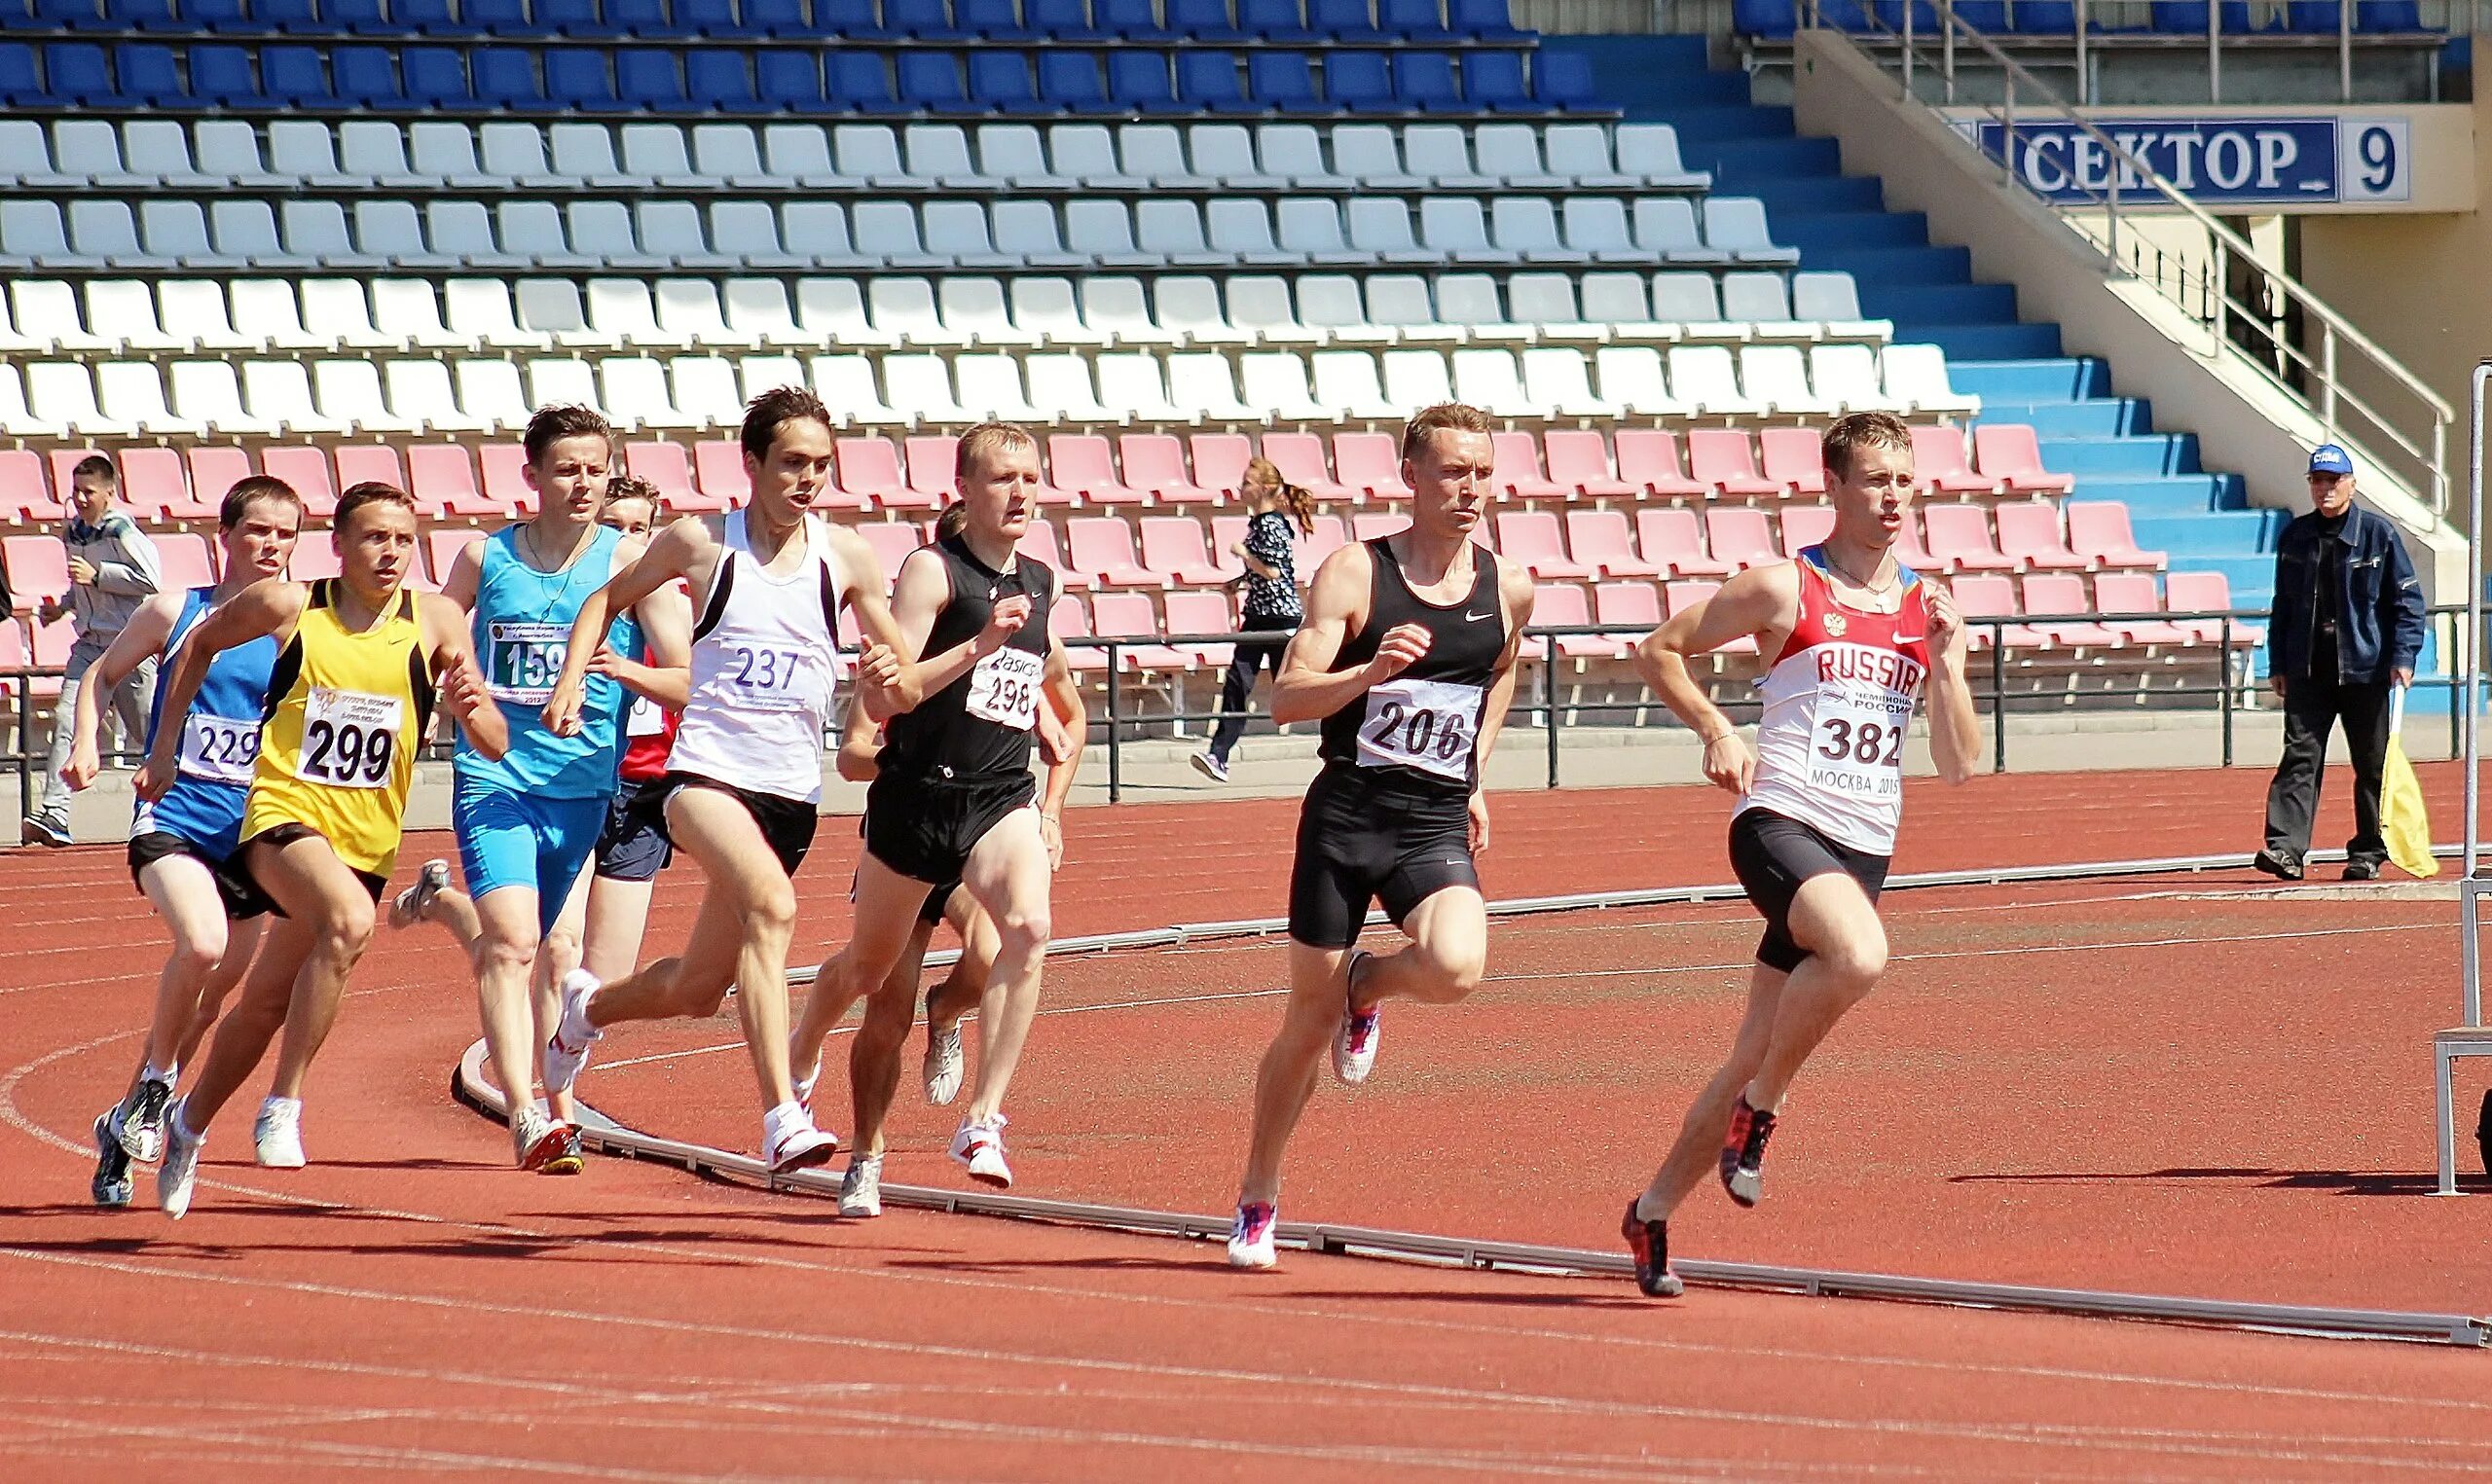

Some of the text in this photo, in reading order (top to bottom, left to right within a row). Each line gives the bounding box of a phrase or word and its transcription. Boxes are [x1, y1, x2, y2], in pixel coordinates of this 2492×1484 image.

[2024, 127, 2397, 195] СЕКТОР 9
[507, 643, 566, 687] 159
[736, 647, 799, 690] 237
[1816, 648, 1920, 696] RUSSIA
[985, 676, 1029, 716] 298
[199, 727, 258, 767] 229
[304, 720, 391, 782] 299
[1372, 702, 1464, 759] 206
[1817, 718, 1902, 767] 382
[1812, 769, 1899, 795] МОСКВА 2015
